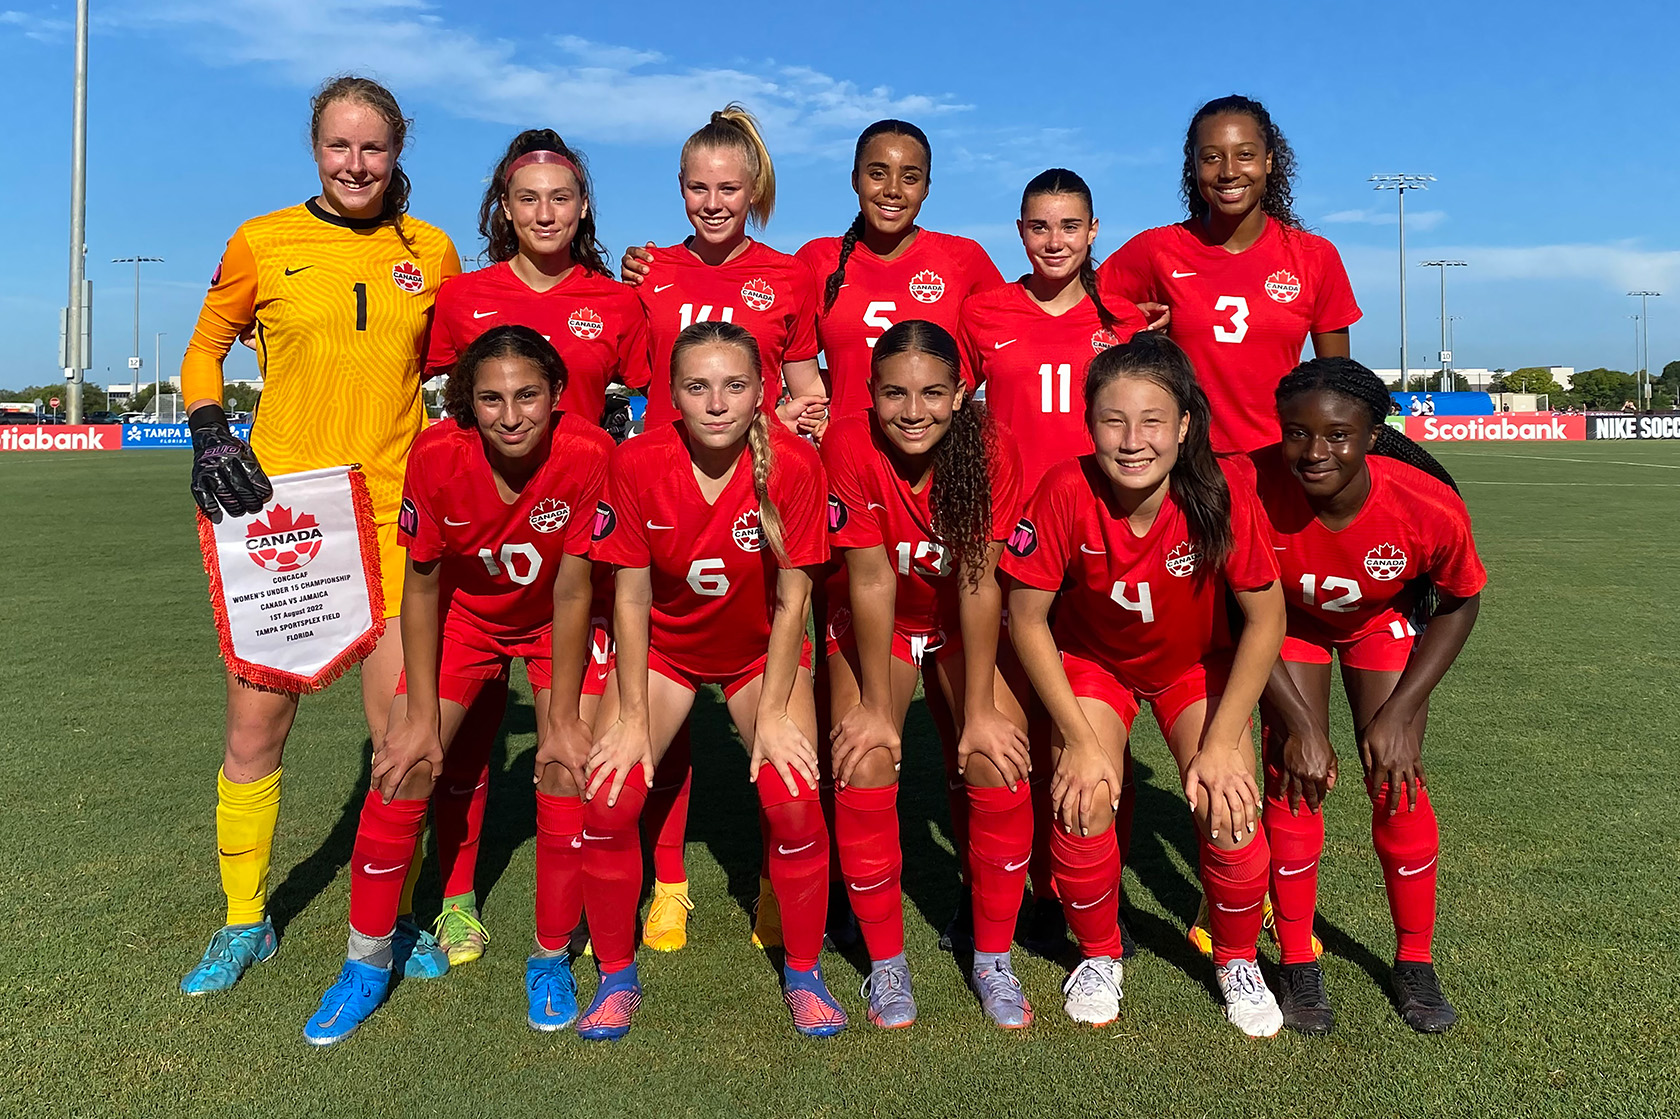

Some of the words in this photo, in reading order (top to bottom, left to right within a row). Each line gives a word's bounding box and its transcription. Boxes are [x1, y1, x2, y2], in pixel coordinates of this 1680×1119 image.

[393, 271, 423, 283] CANADA
[1266, 283, 1299, 292] CANADA
[353, 283, 366, 331] 1
[743, 290, 773, 302] CANADA
[569, 320, 602, 330] CANADA
[863, 301, 897, 348] 5
[1213, 295, 1250, 343] 3
[1038, 363, 1071, 413] 11
[0, 427, 104, 449] tiabank
[144, 428, 180, 438] TAMPA
[1424, 418, 1567, 440] Scotiabank
[1596, 417, 1637, 439] NIKE
[531, 508, 568, 523] CANADA
[245, 528, 323, 551] CANADA
[478, 542, 543, 585] 10
[272, 571, 308, 584] CONCACAF
[686, 558, 730, 596] 6
[232, 591, 265, 604] WOMEN'S
[267, 586, 289, 598] UNDER
[290, 584, 299, 592] 15
[301, 574, 351, 589] CHAMPIONSHIP
[1299, 572, 1363, 613] 12
[260, 599, 288, 611] CANADA
[288, 597, 298, 605] VS
[299, 590, 328, 603] JAMAICA
[1110, 580, 1155, 623] 4
[270, 613, 282, 621] 1ST
[283, 608, 305, 620] August
[307, 603, 323, 614] 2022
[256, 625, 278, 636] TAMPA
[280, 616, 321, 633] SPORTSPLEX
[322, 612, 341, 623] FIELD
[286, 630, 314, 642] FLORIDA
